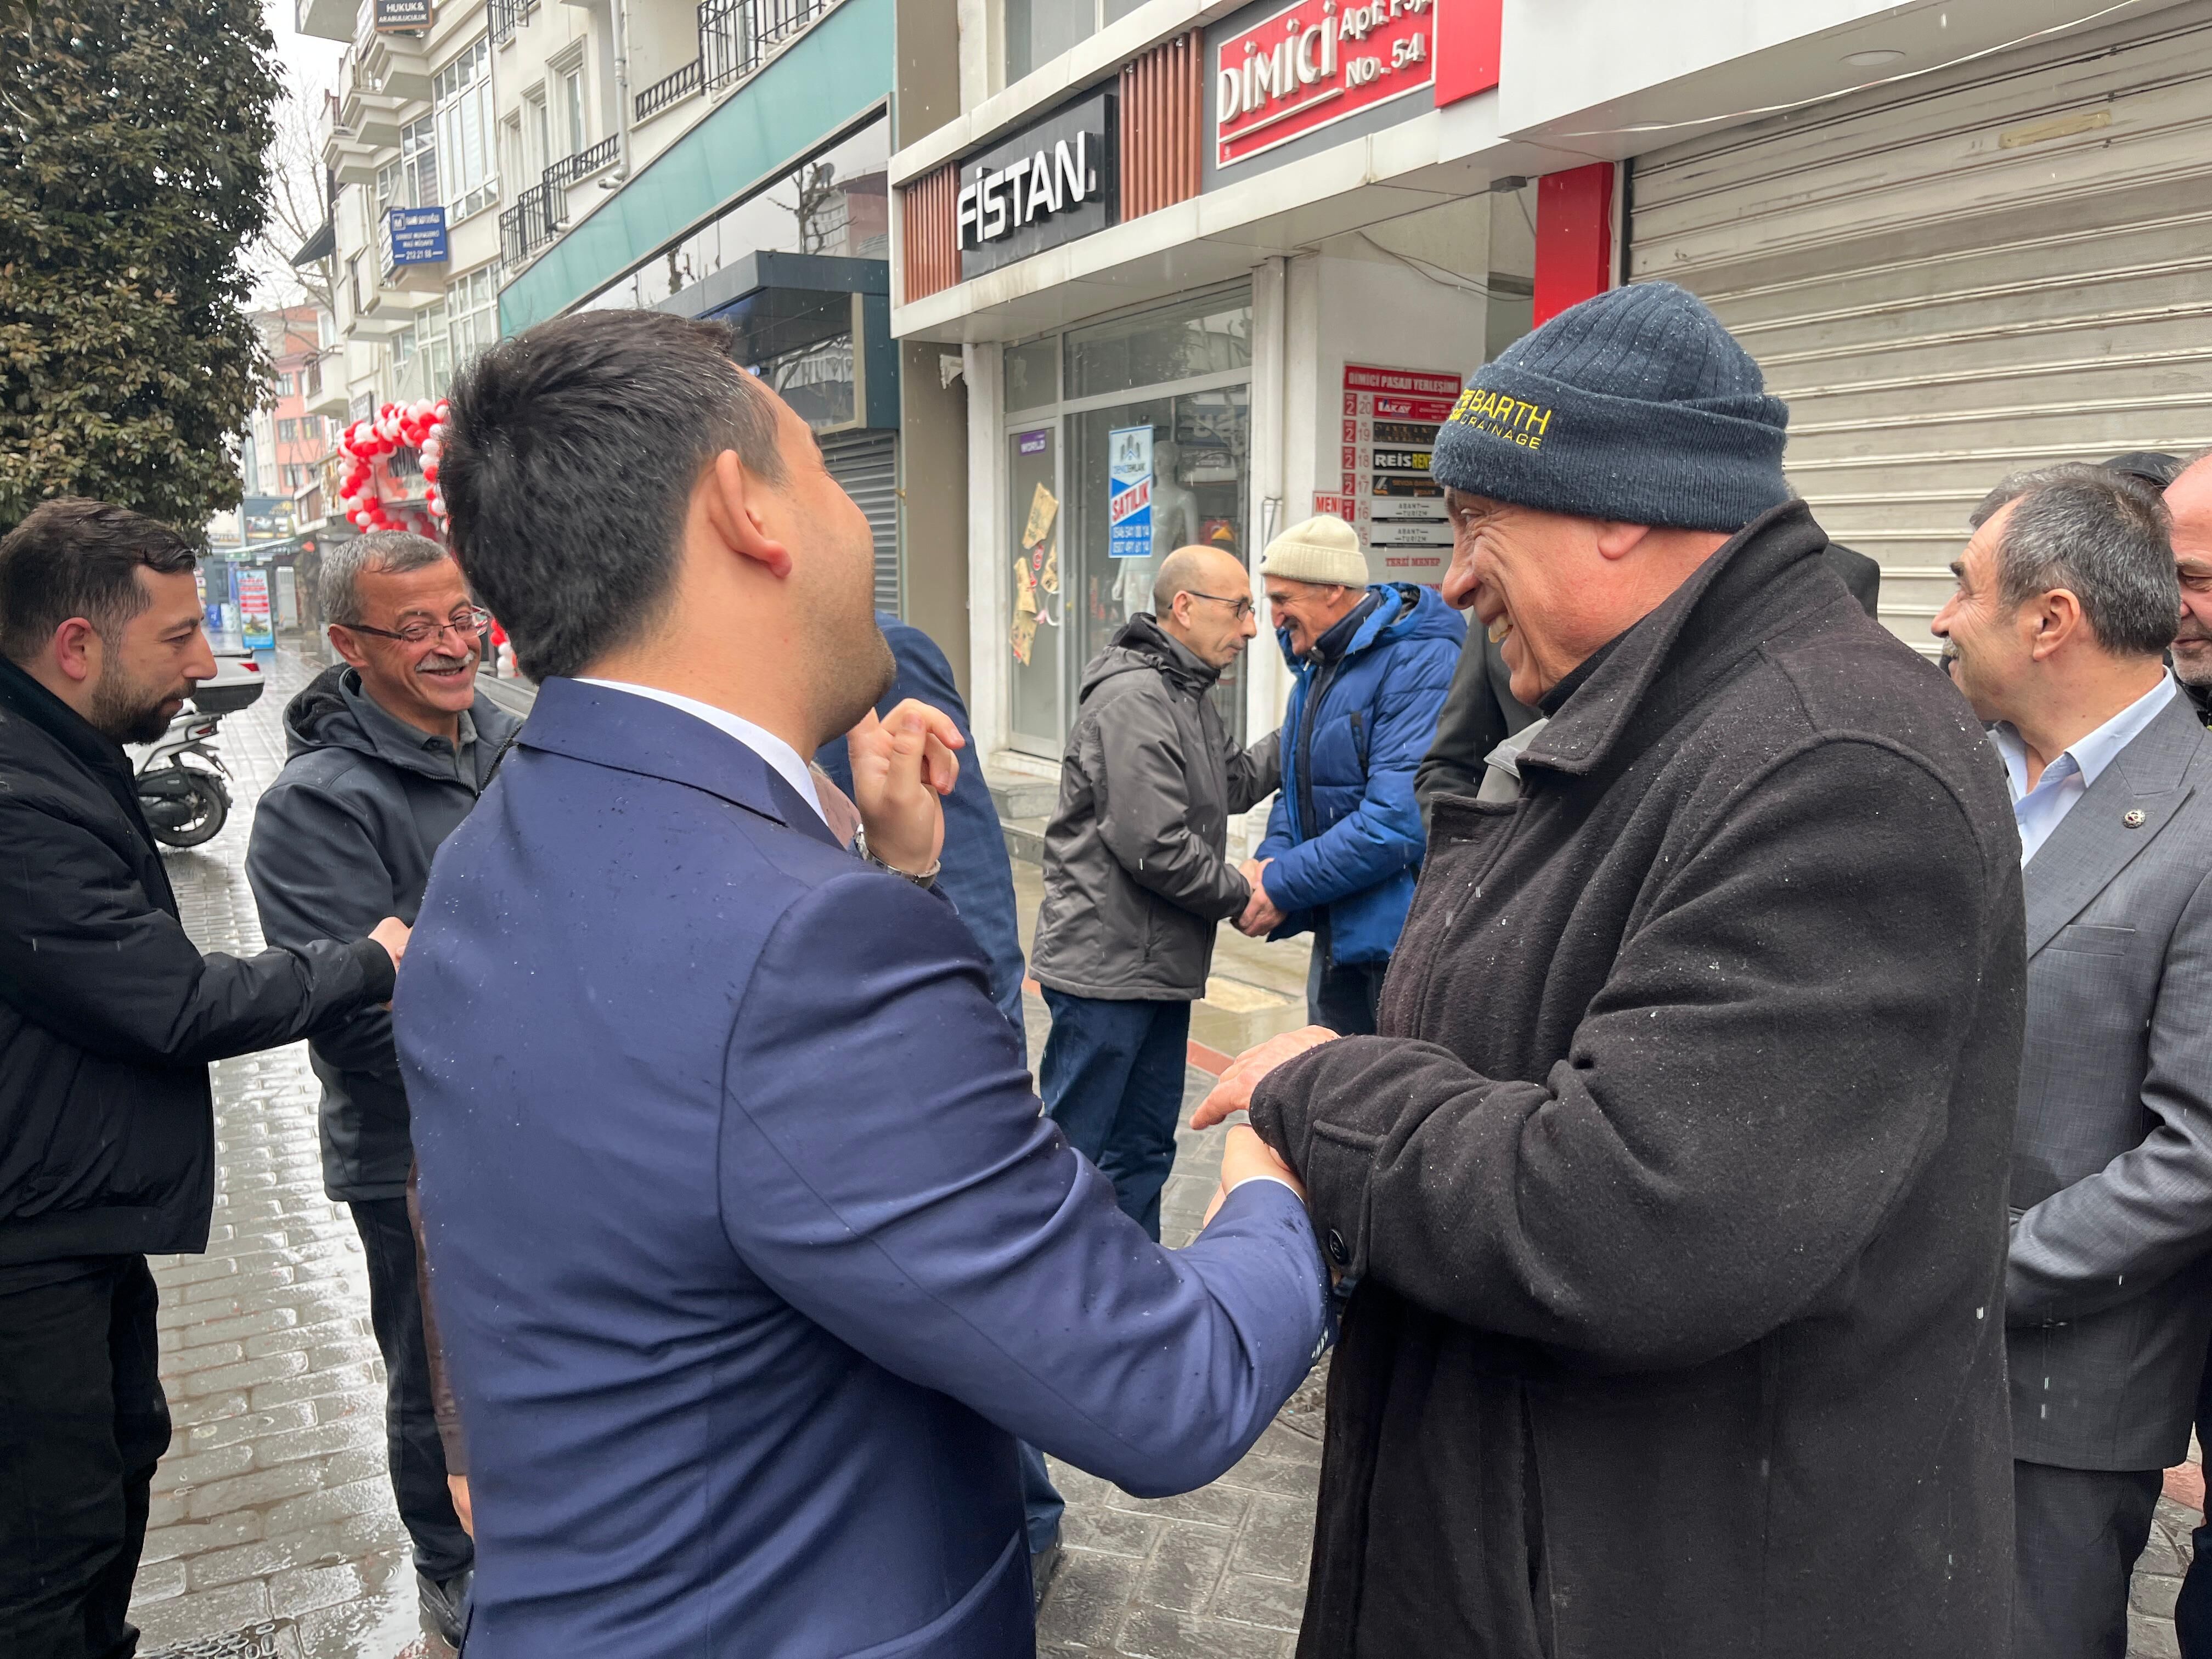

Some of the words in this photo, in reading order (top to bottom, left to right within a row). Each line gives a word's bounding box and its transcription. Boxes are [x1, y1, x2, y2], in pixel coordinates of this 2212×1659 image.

[1391, 32, 1426, 70] 54
[1346, 400, 1354, 414] 2
[1345, 428, 1354, 441] 2
[1459, 413, 1542, 449] DRAINAGE
[1345, 455, 1353, 468] 2
[1375, 453, 1412, 467] REİS
[1345, 481, 1353, 494] 2
[1112, 480, 1150, 522] SATILIK
[1344, 507, 1351, 521] 1
